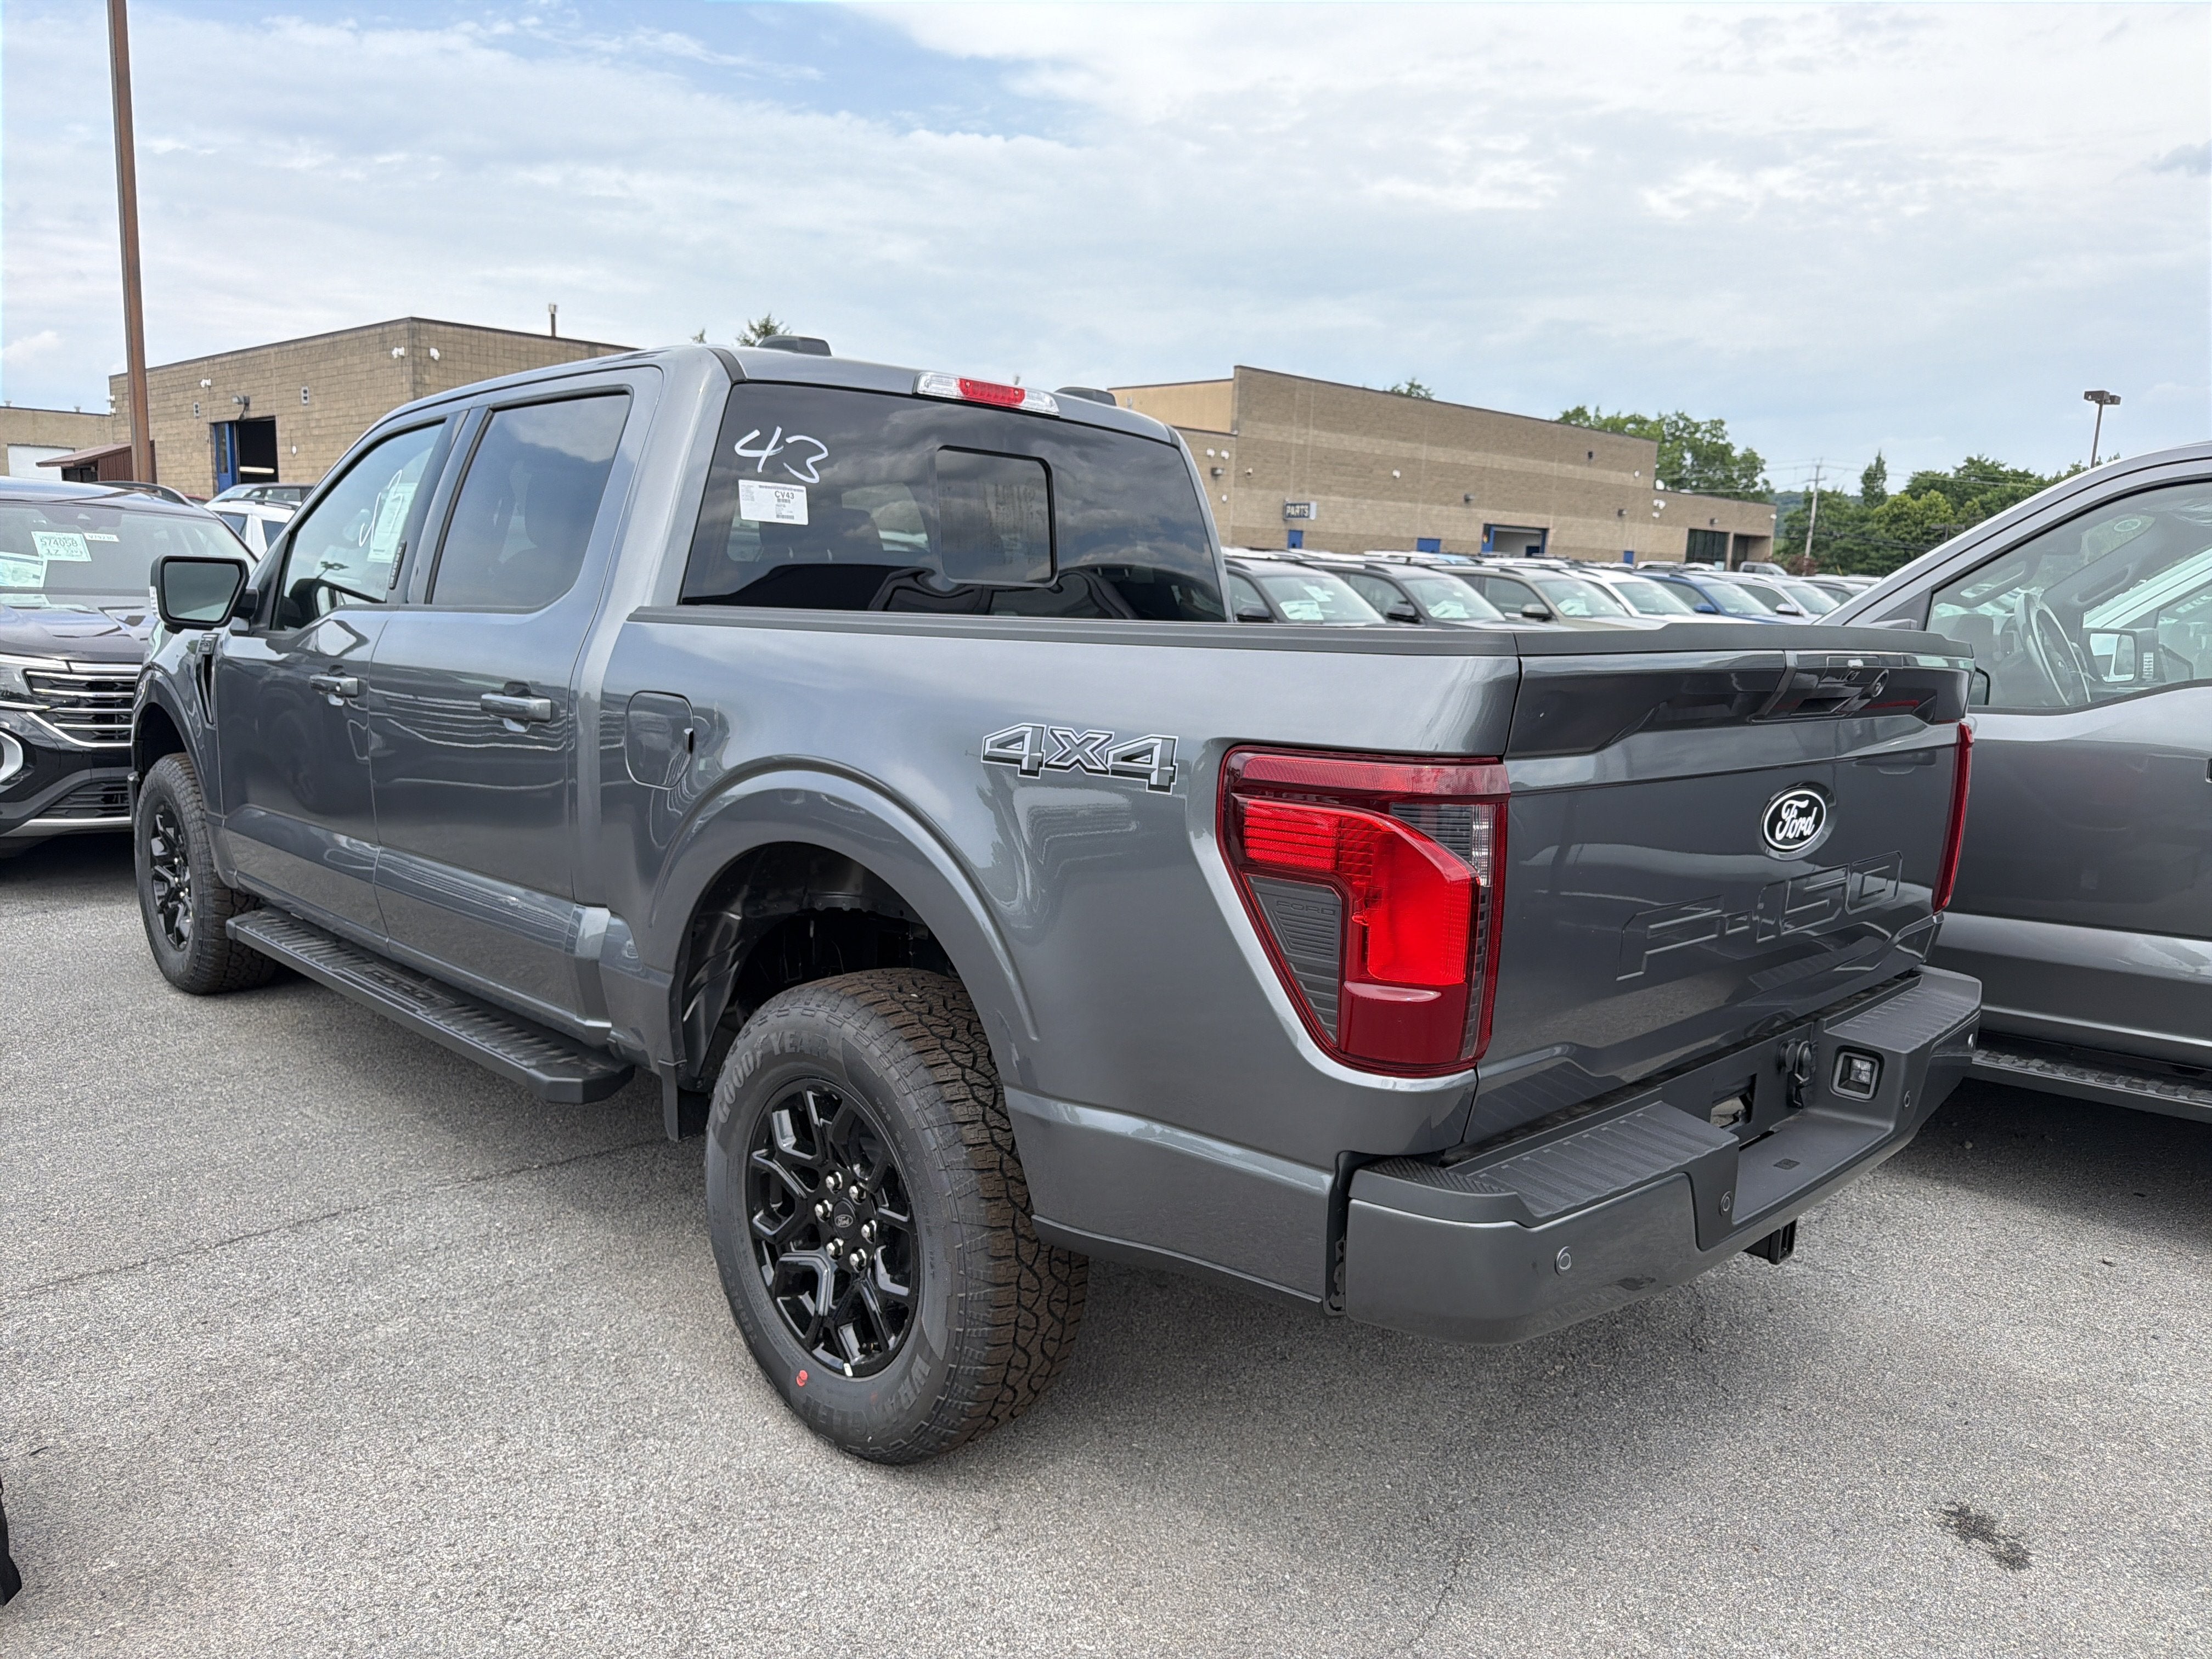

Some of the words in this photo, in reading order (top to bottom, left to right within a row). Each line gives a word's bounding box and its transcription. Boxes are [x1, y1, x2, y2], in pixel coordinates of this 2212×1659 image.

[735, 426, 828, 483] 43
[774, 490, 794, 499] CV43
[1286, 505, 1308, 516] PARTS
[980, 722, 1179, 795] 4X4
[1775, 799, 1818, 841] Ford
[1276, 901, 1335, 916] FORD
[1615, 850, 1903, 981] F-150
[717, 1030, 830, 1124] GOODYEAR
